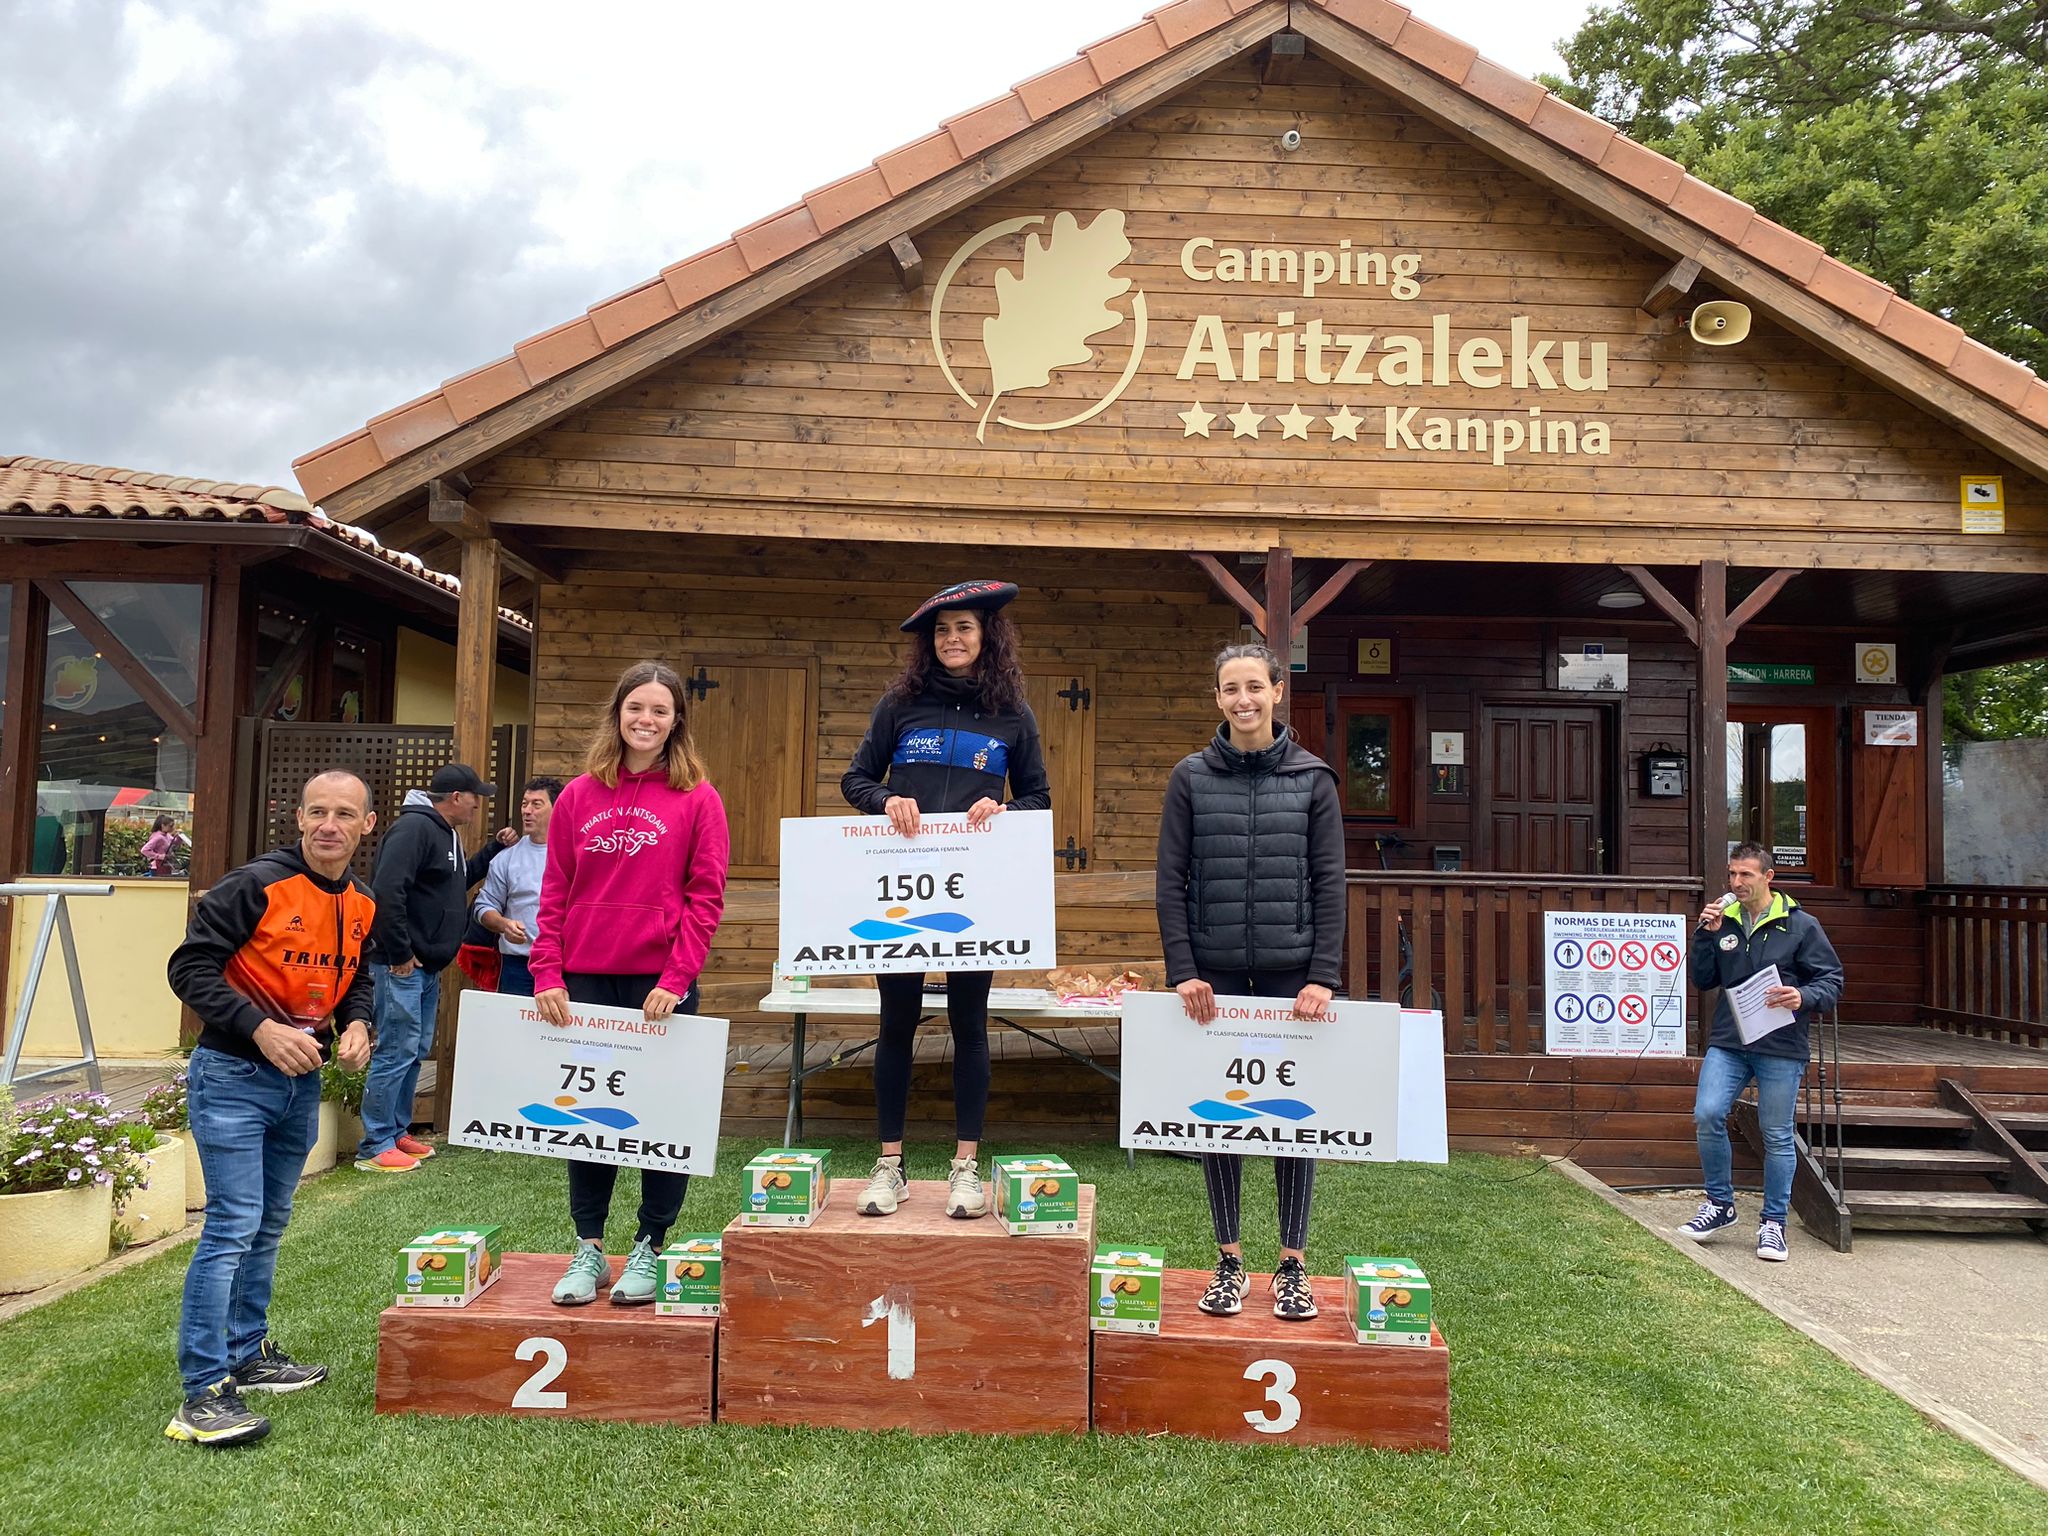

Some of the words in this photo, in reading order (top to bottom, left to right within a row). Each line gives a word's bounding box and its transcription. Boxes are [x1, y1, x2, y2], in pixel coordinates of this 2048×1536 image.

[1180, 236, 1422, 301] Camping
[1176, 311, 1609, 392] Aritzaleku
[1384, 406, 1611, 466] Kanpina
[1727, 667, 1767, 680] ECEPCION
[1773, 668, 1812, 681] HARRERA
[1875, 713, 1906, 721] TIENDA
[842, 824, 900, 837] TRIATLO
[916, 822, 992, 836] RITZALEKU
[877, 873, 935, 902] 150
[945, 872, 965, 900] €
[1554, 917, 1599, 926] NORMAS
[1602, 918, 1615, 927] DE
[1618, 919, 1631, 927] LA
[1633, 919, 1677, 928] PISCINA
[793, 939, 1031, 963] ARITZALEKU
[794, 963, 891, 971] TRIATLON
[925, 959, 1032, 967] TRIATLOIA
[587, 1017, 667, 1036] ARITZALEKU
[1249, 1031, 1282, 1039] CATEGORÍA
[547, 1036, 581, 1045] CLASIFICADA
[582, 1039, 613, 1048] CATEGORÍA
[613, 1043, 643, 1052] FEMENINA
[560, 1063, 596, 1093] 75
[606, 1070, 627, 1097] €
[1225, 1057, 1266, 1085] 40
[1276, 1060, 1296, 1087] €
[462, 1119, 692, 1161] ARITZALEKU
[1132, 1120, 1373, 1147] ARITZALEKU
[1132, 1139, 1230, 1149] TRIATLON
[1264, 1145, 1373, 1156] TRIATLOIA
[462, 1136, 555, 1153] TRIATLON
[588, 1152, 691, 1170] TRIATLOIA
[861, 1292, 916, 1380] 1
[511, 1336, 568, 1409] 2
[1242, 1358, 1302, 1434] 3
